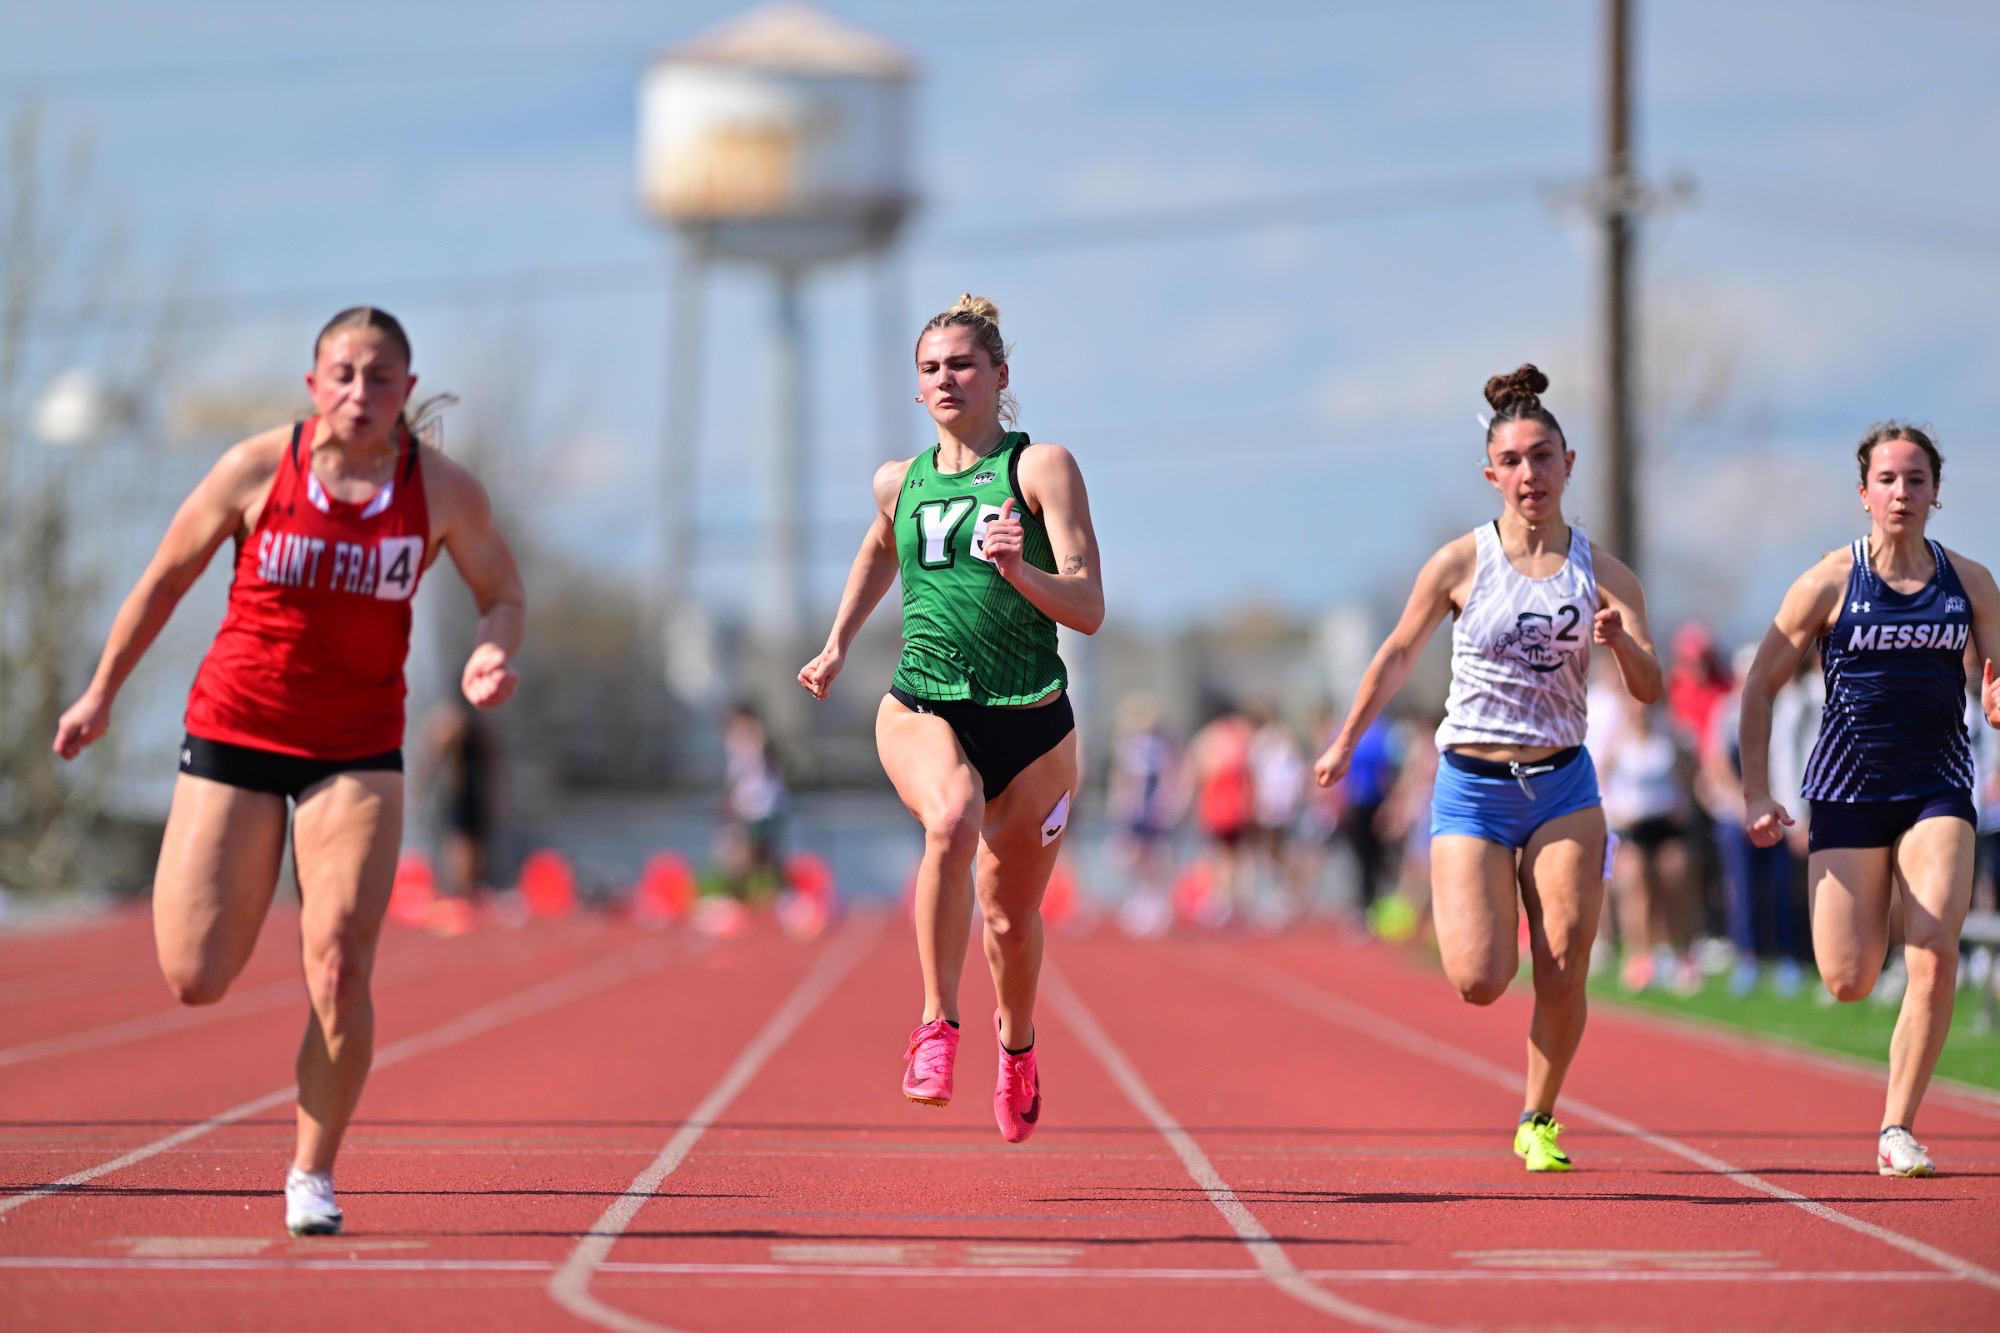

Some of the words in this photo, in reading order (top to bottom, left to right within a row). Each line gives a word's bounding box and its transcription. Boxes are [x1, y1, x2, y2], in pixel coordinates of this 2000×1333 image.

[911, 496, 977, 571] Y
[256, 530, 326, 588] SAINT
[385, 546, 411, 590] 4
[1555, 605, 1580, 641] 2
[1848, 624, 1970, 652] MESSIAH
